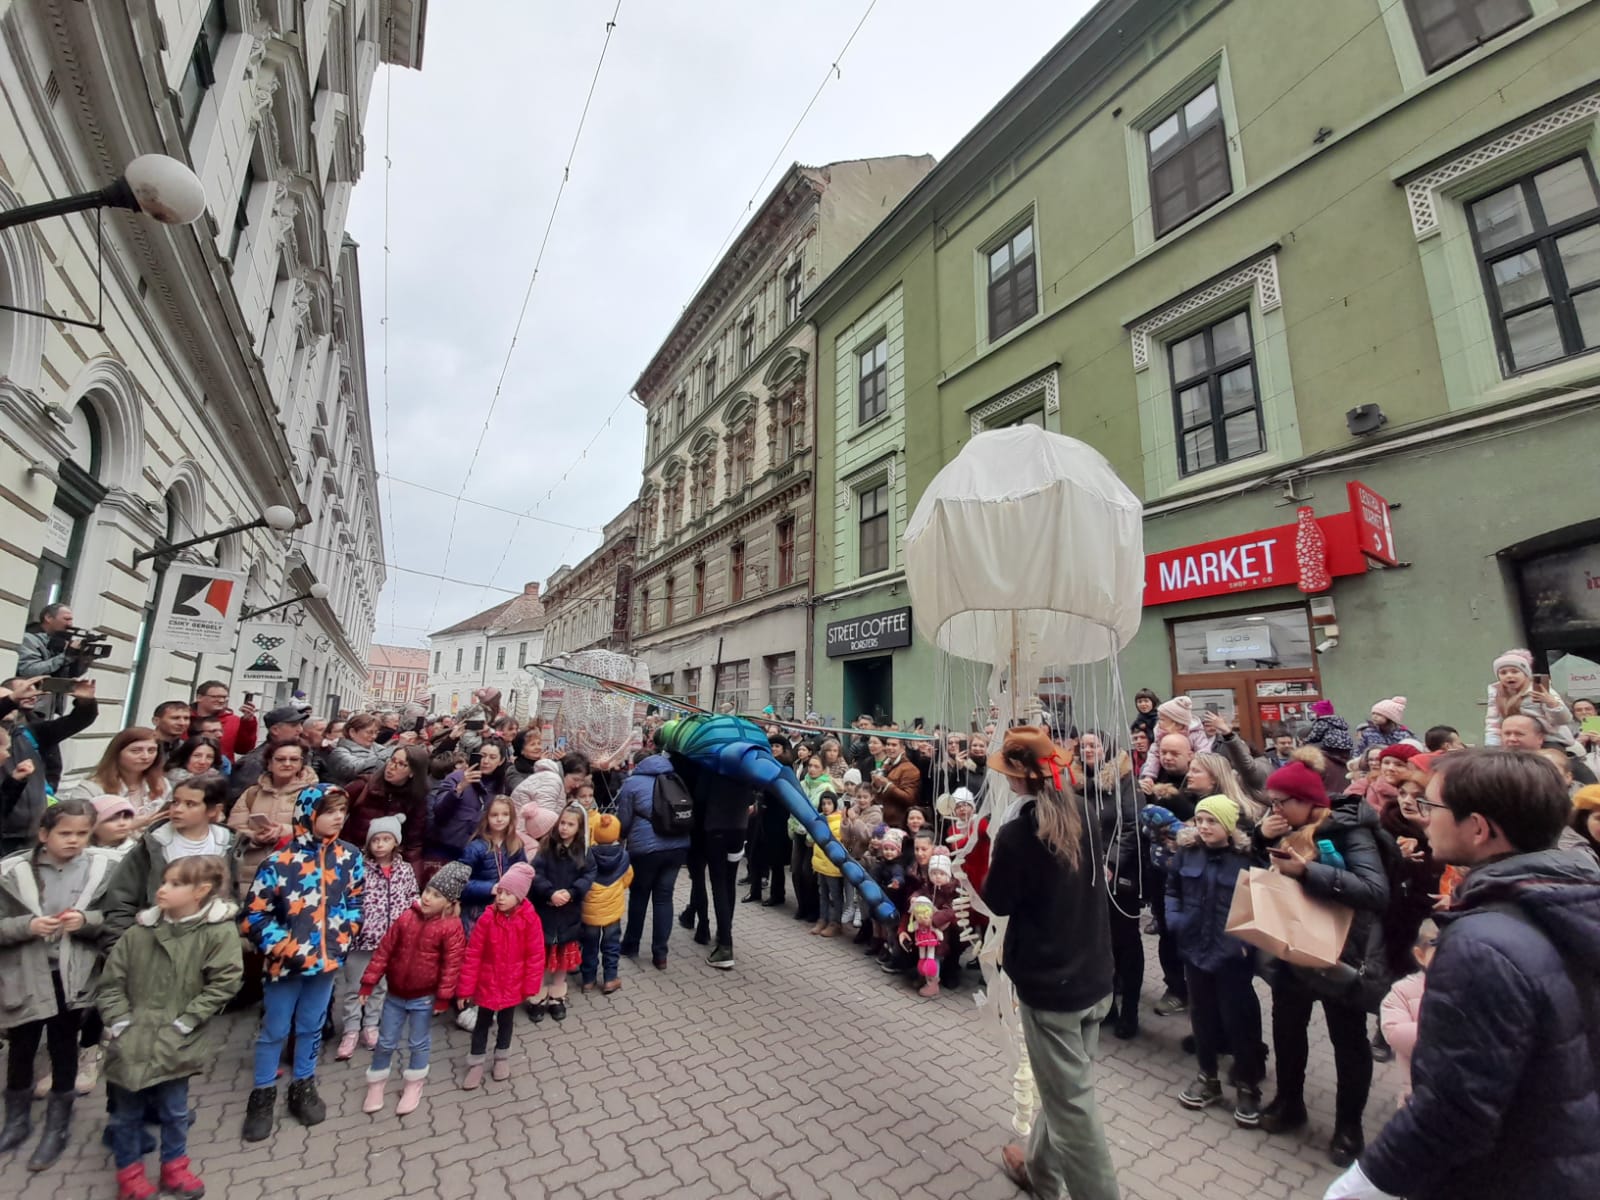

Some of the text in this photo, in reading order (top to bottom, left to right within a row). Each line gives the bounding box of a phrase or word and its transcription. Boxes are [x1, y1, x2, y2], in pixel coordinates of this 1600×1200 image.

[1159, 539, 1277, 592] MARKET
[1229, 580, 1248, 589] SHOP
[1262, 576, 1273, 584] GO
[191, 622, 224, 631] GERGELY
[828, 613, 907, 644] STREET COFFEE
